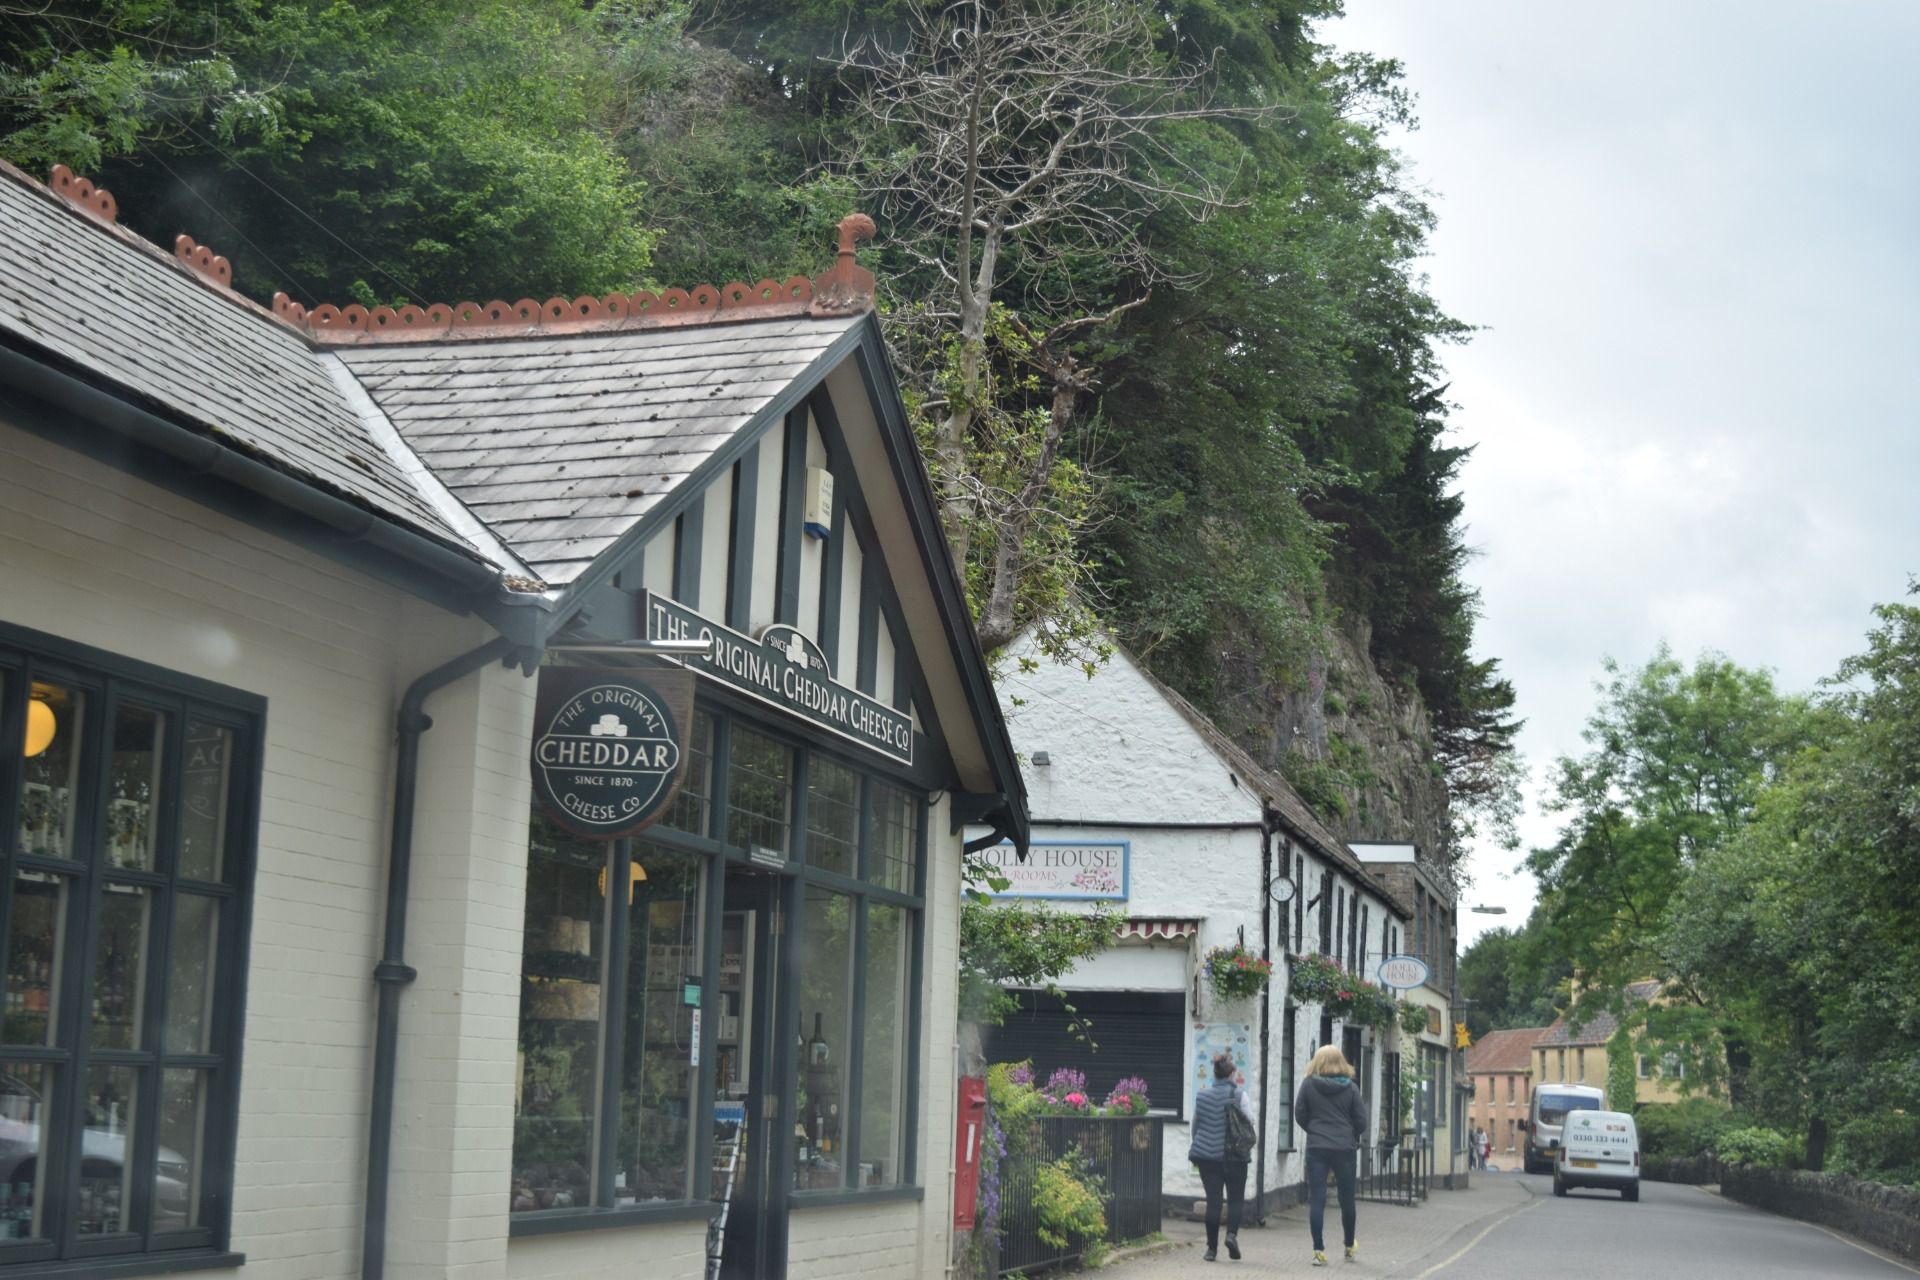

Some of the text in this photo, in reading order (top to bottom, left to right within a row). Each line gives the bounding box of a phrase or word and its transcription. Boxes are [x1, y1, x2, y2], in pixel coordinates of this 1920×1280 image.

[770, 635, 786, 653] SINCE
[653, 603, 689, 641] THE
[700, 626, 780, 693] ORIGINAL
[784, 667, 848, 724] CHEDDAR
[850, 699, 893, 745] CHEESE
[558, 690, 660, 733] THE ORIGINAL
[540, 740, 669, 768] CHEDDAR
[574, 775, 634, 788] SINCE 1870
[564, 793, 616, 820] CHEESE
[1045, 849, 1118, 868] HOUSE
[1013, 870, 1058, 881] ROOMS
